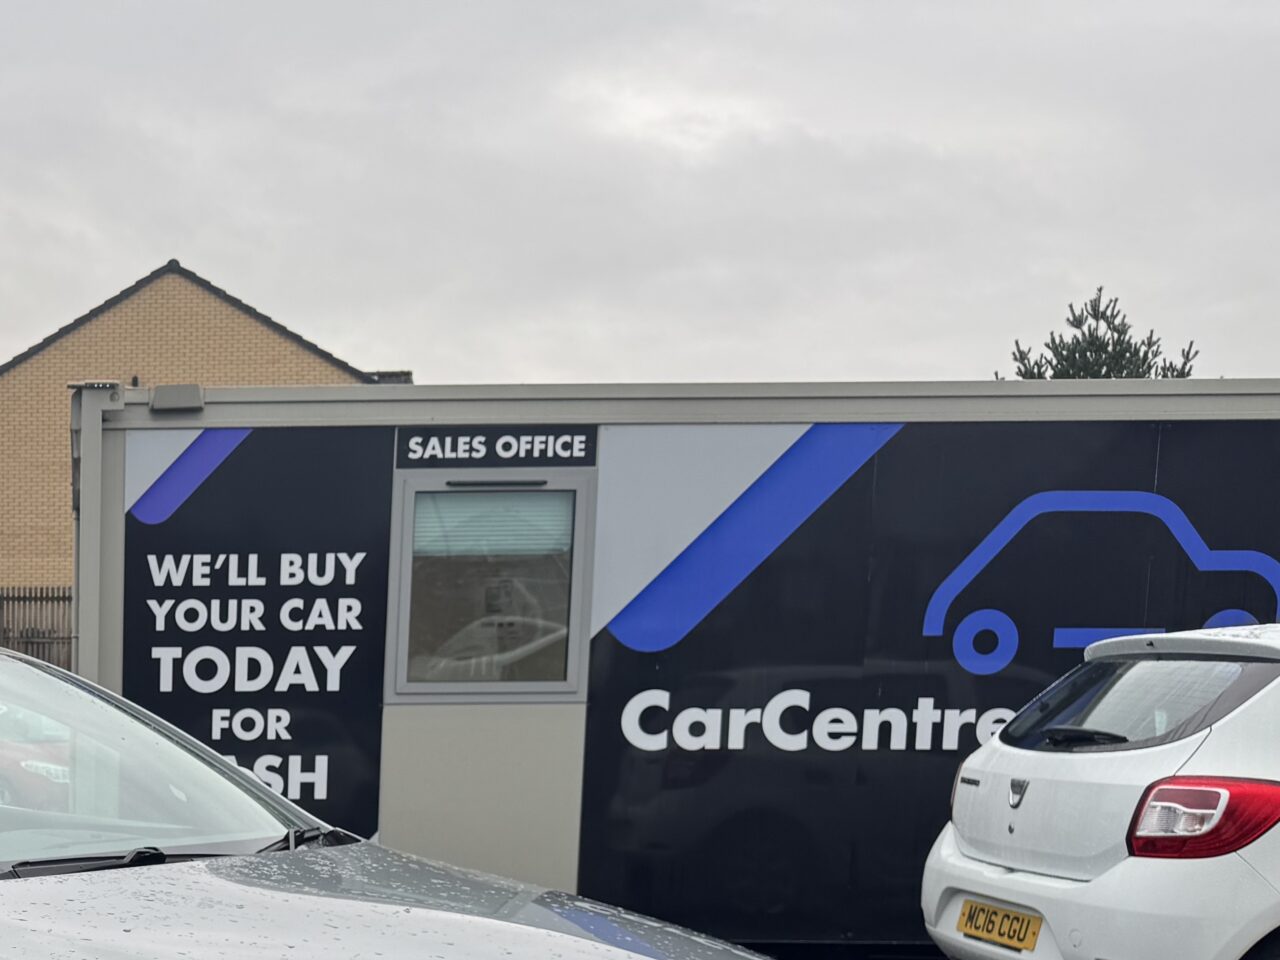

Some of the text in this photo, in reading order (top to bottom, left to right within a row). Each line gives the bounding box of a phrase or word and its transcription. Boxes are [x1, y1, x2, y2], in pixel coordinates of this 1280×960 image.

[407, 434, 587, 460] SALES OFFICE
[147, 552, 367, 587] WE'LL BUY
[146, 598, 363, 632] YOUR CAR
[151, 645, 357, 693] TODAY
[211, 708, 292, 740] FOR
[620, 688, 1018, 752] CarCentre
[998, 913, 1031, 942] CGU
